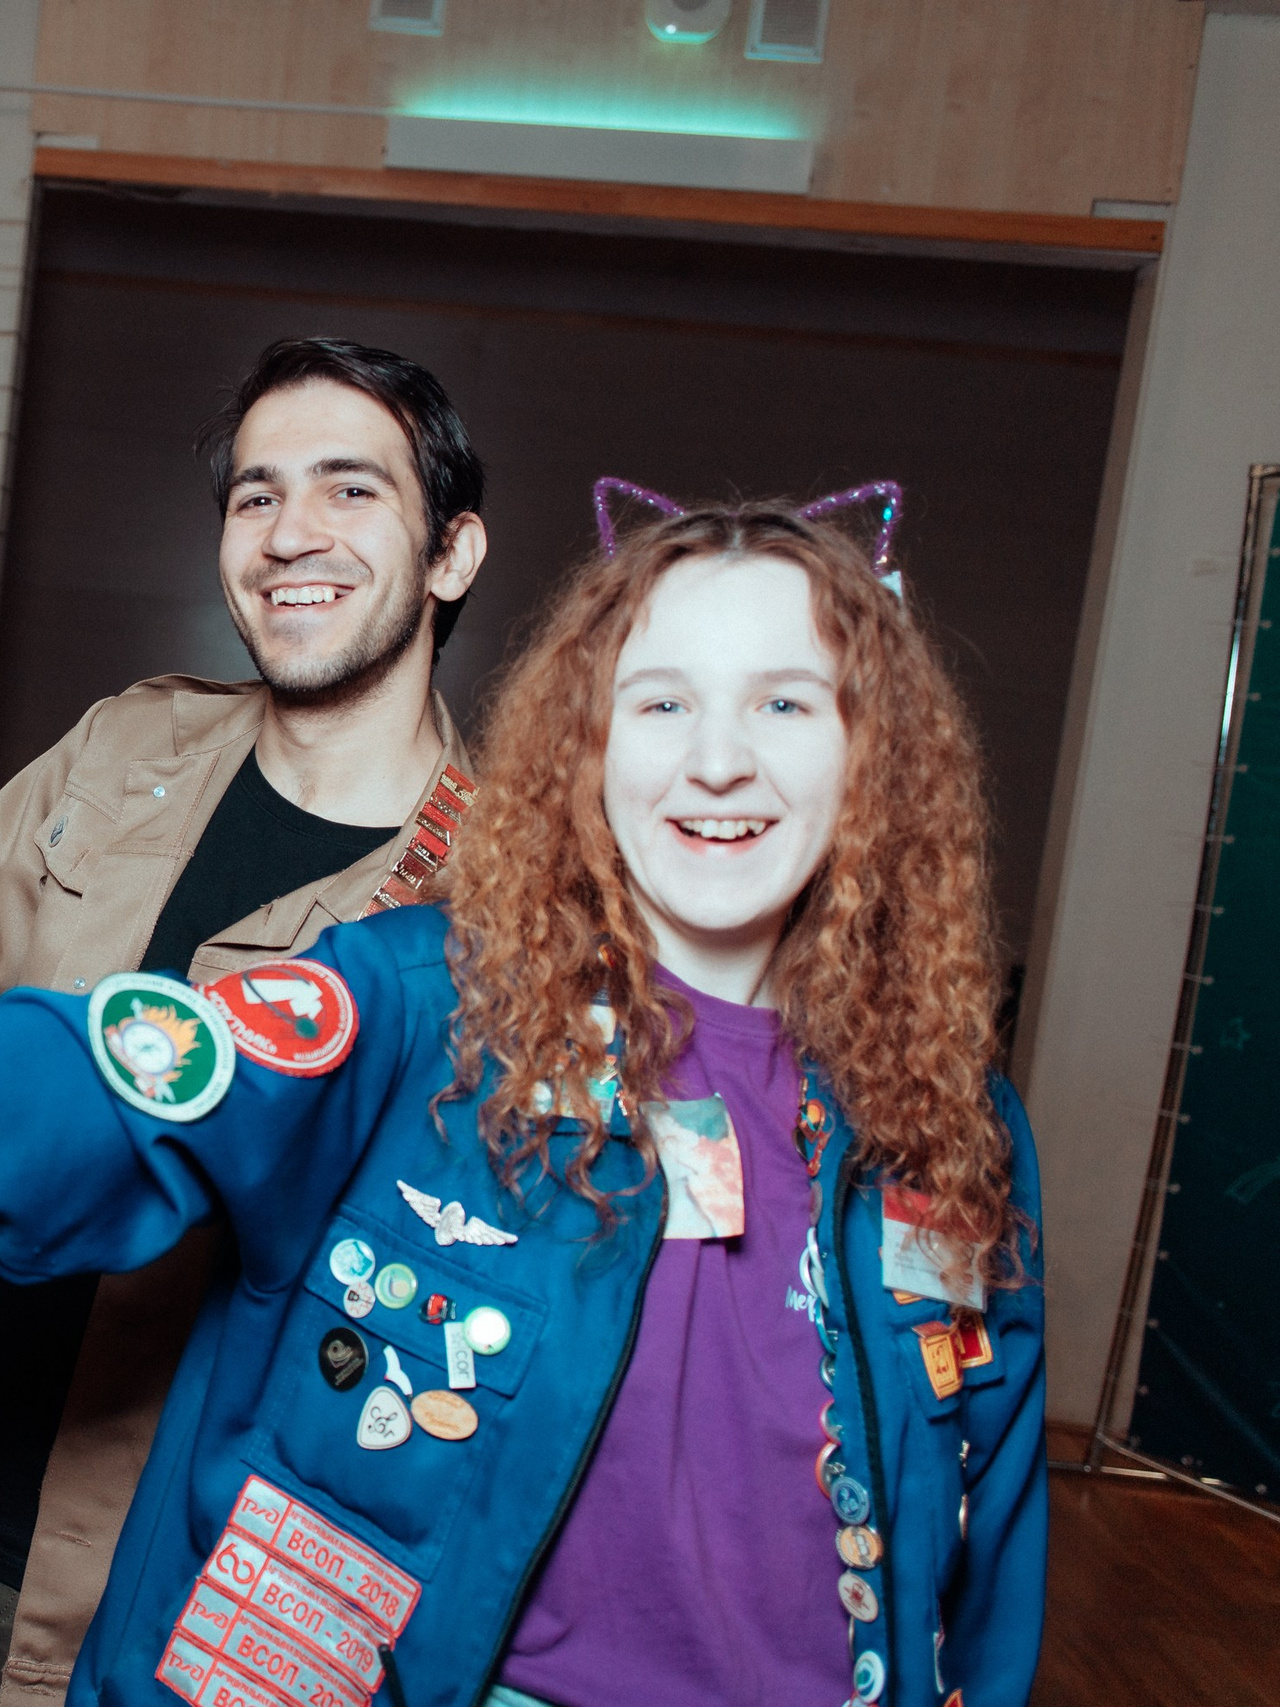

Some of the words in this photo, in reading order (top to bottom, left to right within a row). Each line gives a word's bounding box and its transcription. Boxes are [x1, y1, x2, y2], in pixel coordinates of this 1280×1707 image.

[287, 1528, 346, 1579] ВСОП
[357, 1573, 401, 1619] 2018
[237, 1634, 300, 1687] ВСОП
[262, 1585, 325, 1635] ВСОП
[336, 1627, 376, 1674] 2019
